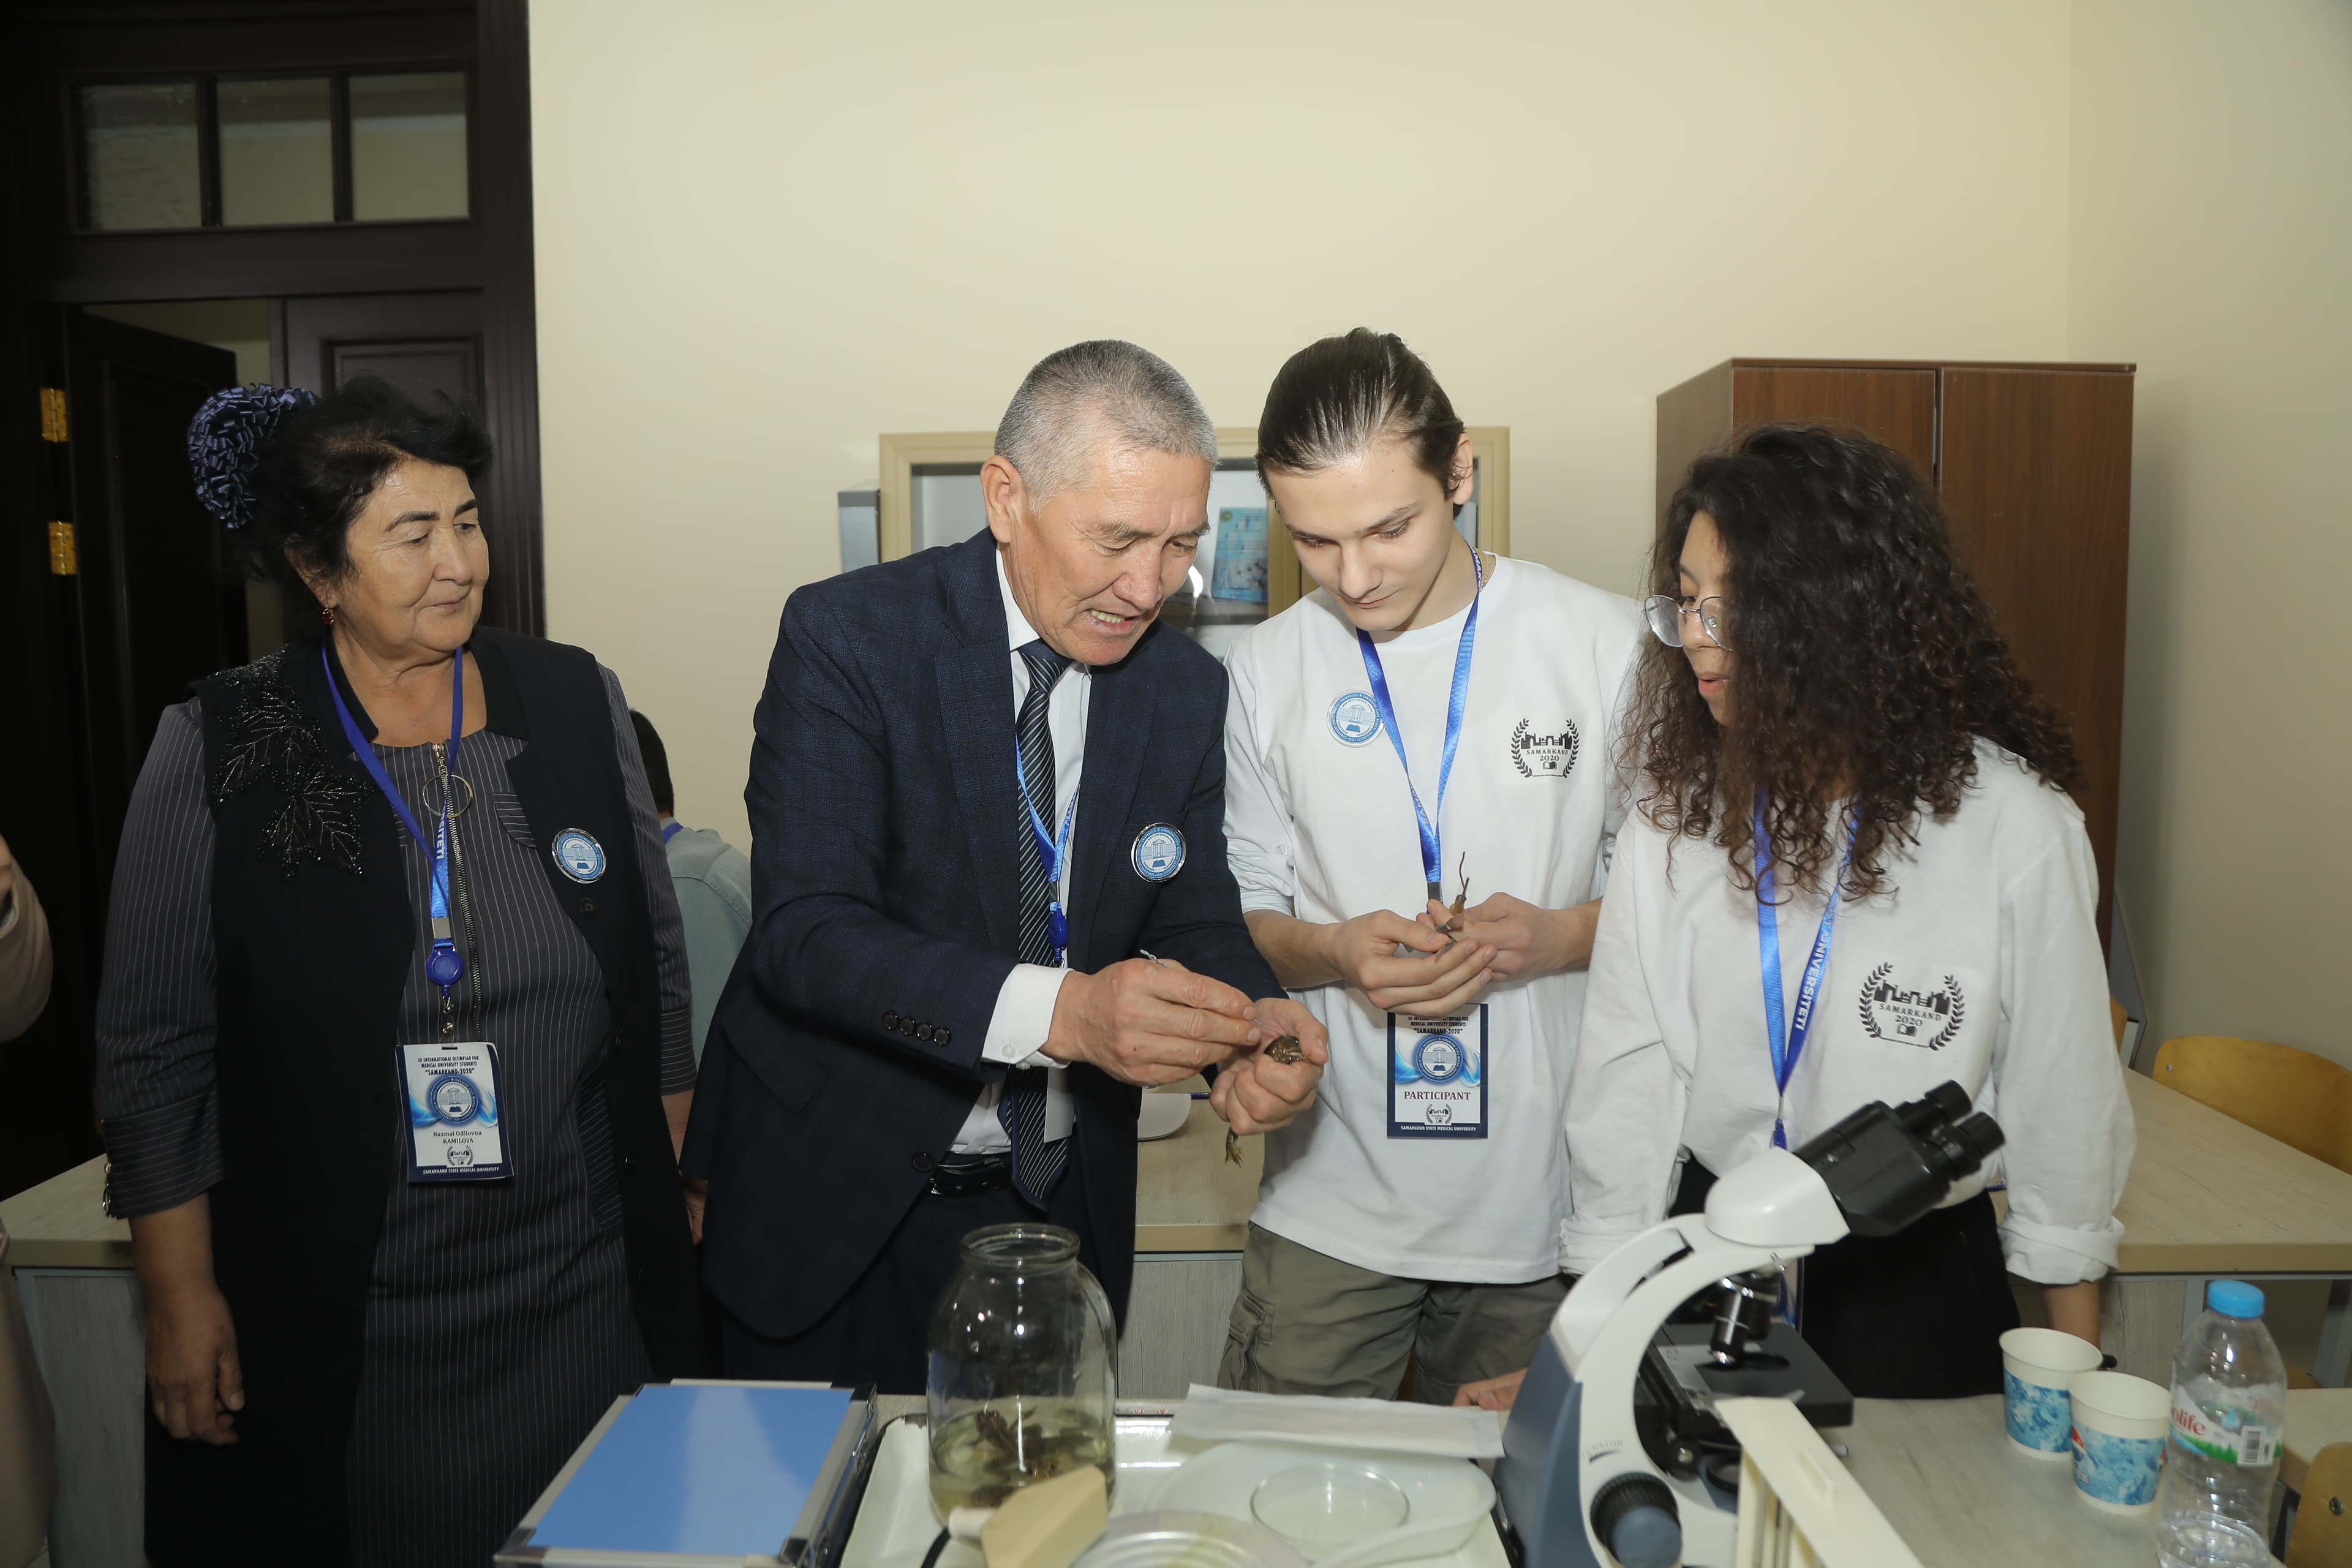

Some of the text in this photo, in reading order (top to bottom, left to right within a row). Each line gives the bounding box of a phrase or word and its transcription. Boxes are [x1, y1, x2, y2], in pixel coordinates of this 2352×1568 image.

[1795, 932, 1830, 1031] UNIVERSITETI
[1879, 1003, 1942, 1021] SAMARKAND
[1895, 1015, 1923, 1027] 2020
[1404, 1091, 1471, 1100] PARTICIPANT
[2171, 1400, 2206, 1435] olife
